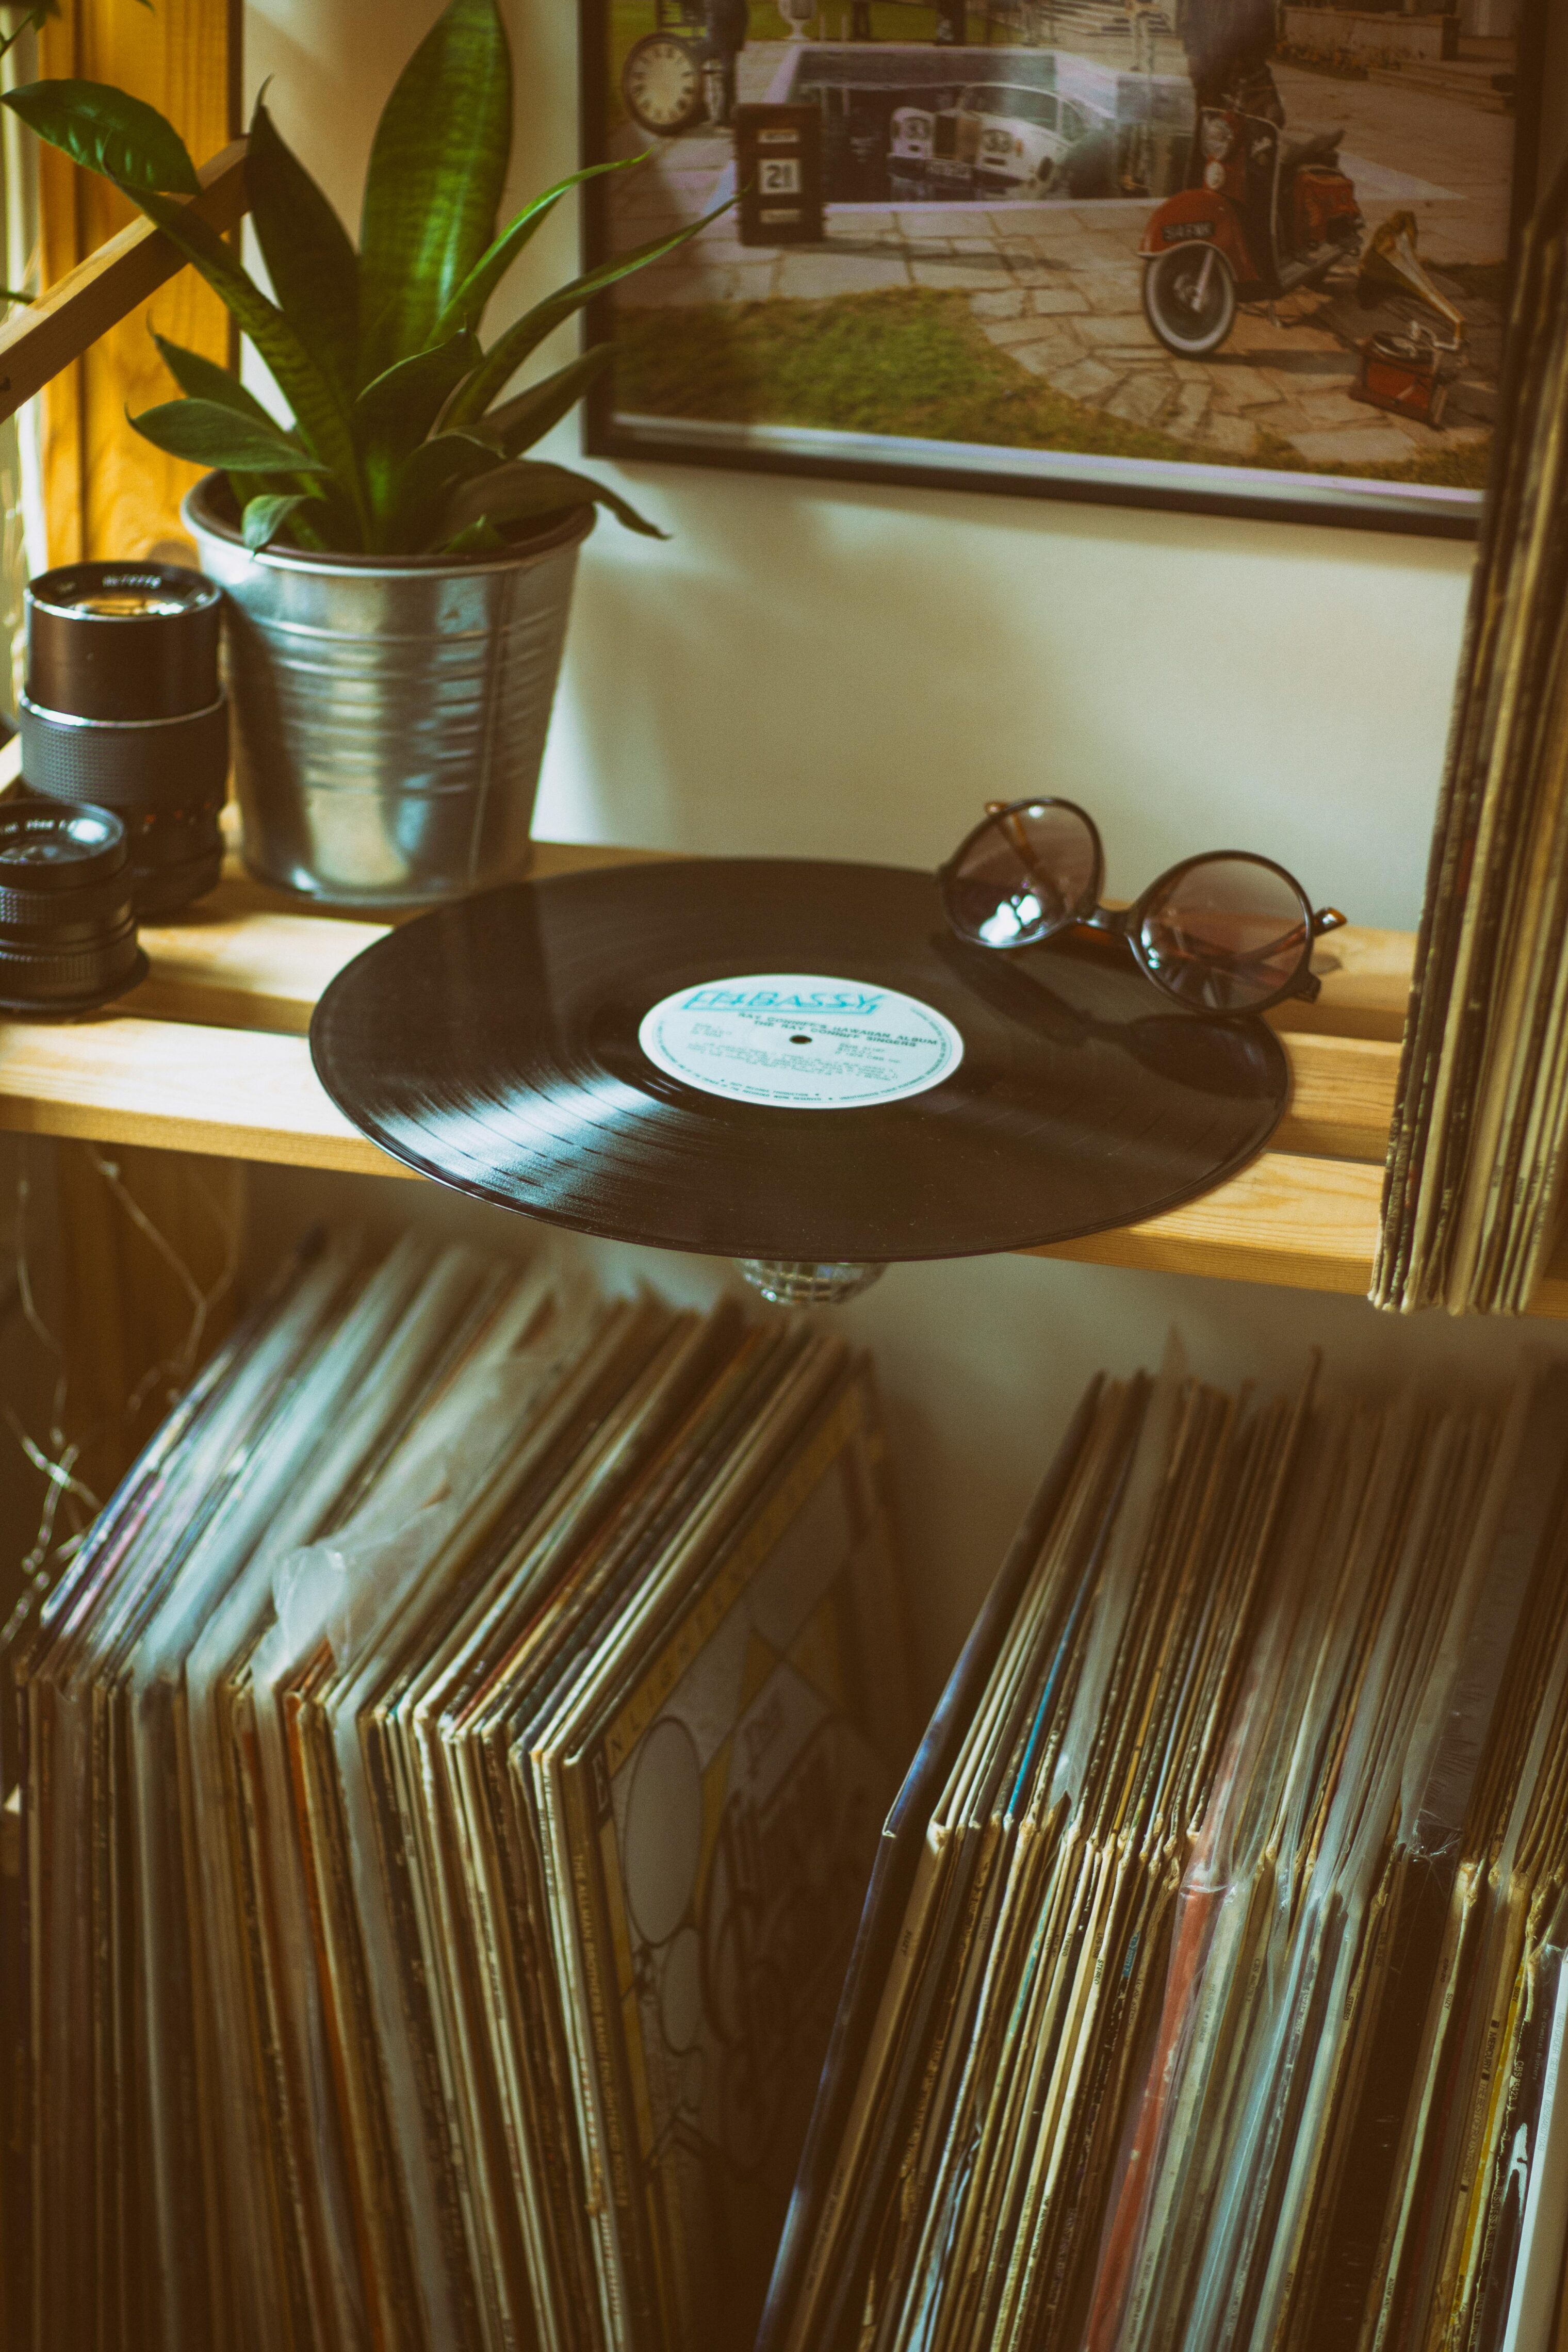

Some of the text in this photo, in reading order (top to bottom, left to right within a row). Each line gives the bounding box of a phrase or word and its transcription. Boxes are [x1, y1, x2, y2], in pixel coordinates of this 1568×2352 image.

[810, 1028, 860, 1039] CONNIFF
[866, 1036, 916, 1047] SINGERS
[833, 1026, 891, 1038] HAWAIIAN
[896, 1035, 937, 1045] ALBUM
[573, 1854, 586, 1880] THE
[576, 1882, 594, 1938] ALLMAN
[1061, 1932, 1073, 1957] STEREO
[583, 1941, 603, 2013] BROTHERS
[1093, 1958, 1104, 1985] STEREO
[1443, 1992, 1453, 2010] SUZY
[1512, 1986, 1521, 2003] SUZY
[1342, 1995, 1354, 2021] STEREO
[1555, 2012, 1565, 2029] NEW
[1537, 2021, 1547, 2050] Chemical
[1551, 2029, 1562, 2054] ORDER
[1481, 2031, 1498, 2071] MERCURY
[1512, 2060, 1525, 2078] CBS
[1532, 2052, 1542, 2080] Brothers
[1549, 2057, 1558, 2071] GET
[1545, 2071, 1556, 2096] READY
[1489, 2185, 1503, 2224] BUSINESS
[1482, 2235, 1495, 2262] USUAL
[1385, 2277, 1395, 2296] ADAM
[1475, 2292, 1485, 2308] MEN
[1469, 2320, 1481, 2346] WORK
